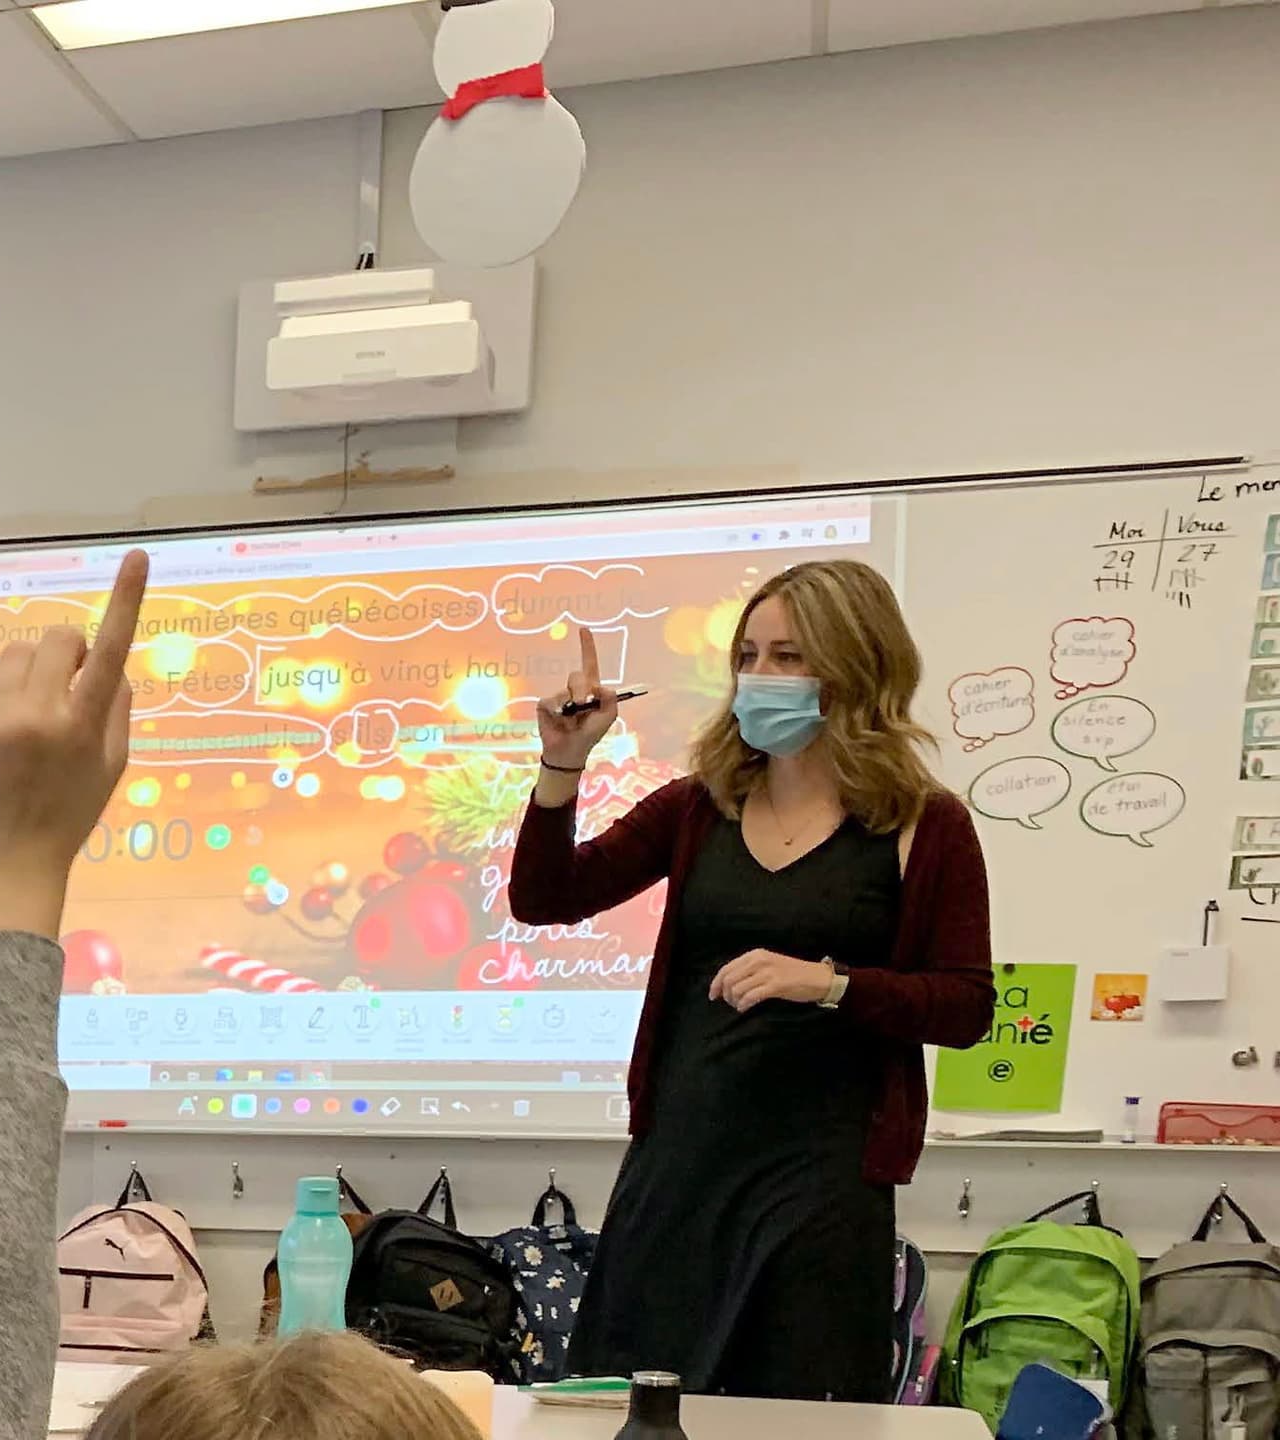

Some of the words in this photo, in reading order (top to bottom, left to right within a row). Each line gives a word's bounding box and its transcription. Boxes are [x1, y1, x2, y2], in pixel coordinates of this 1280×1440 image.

[1197, 475, 1223, 502] Le
[1101, 550, 1136, 570] 29
[1176, 542, 1221, 563] 27
[289, 595, 478, 634] québécoises
[132, 676, 156, 697] es
[262, 660, 367, 696] jusqu'à
[381, 656, 453, 688] vingt
[81, 818, 194, 863] 0:00
